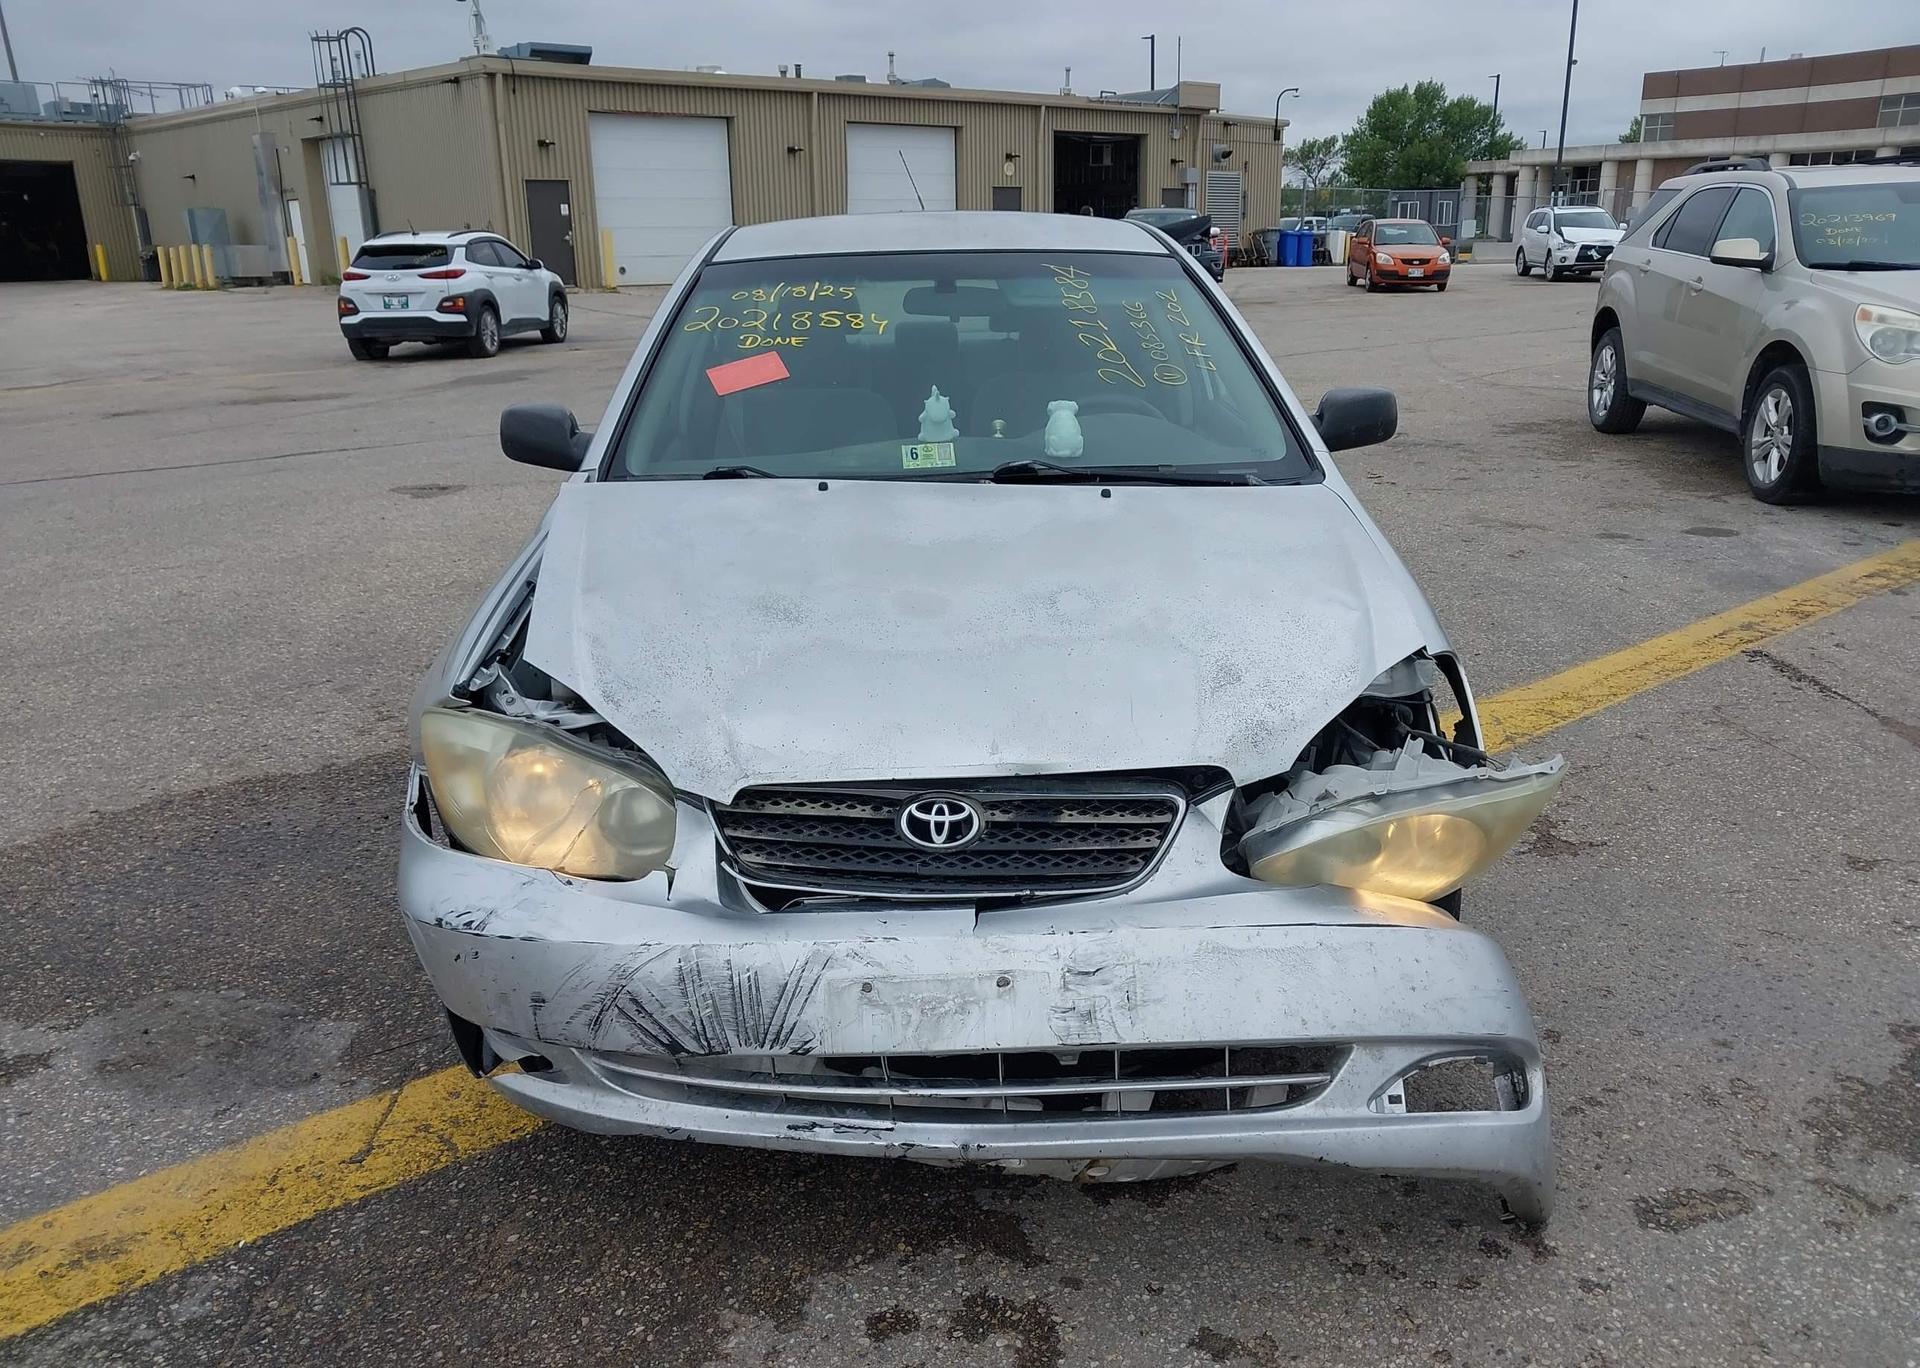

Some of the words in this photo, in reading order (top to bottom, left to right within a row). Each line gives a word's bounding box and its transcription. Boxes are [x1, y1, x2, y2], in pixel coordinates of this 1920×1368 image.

[731, 281, 856, 302] 08/18/25
[737, 333, 811, 349] DONE
[909, 446, 919, 461] 6
